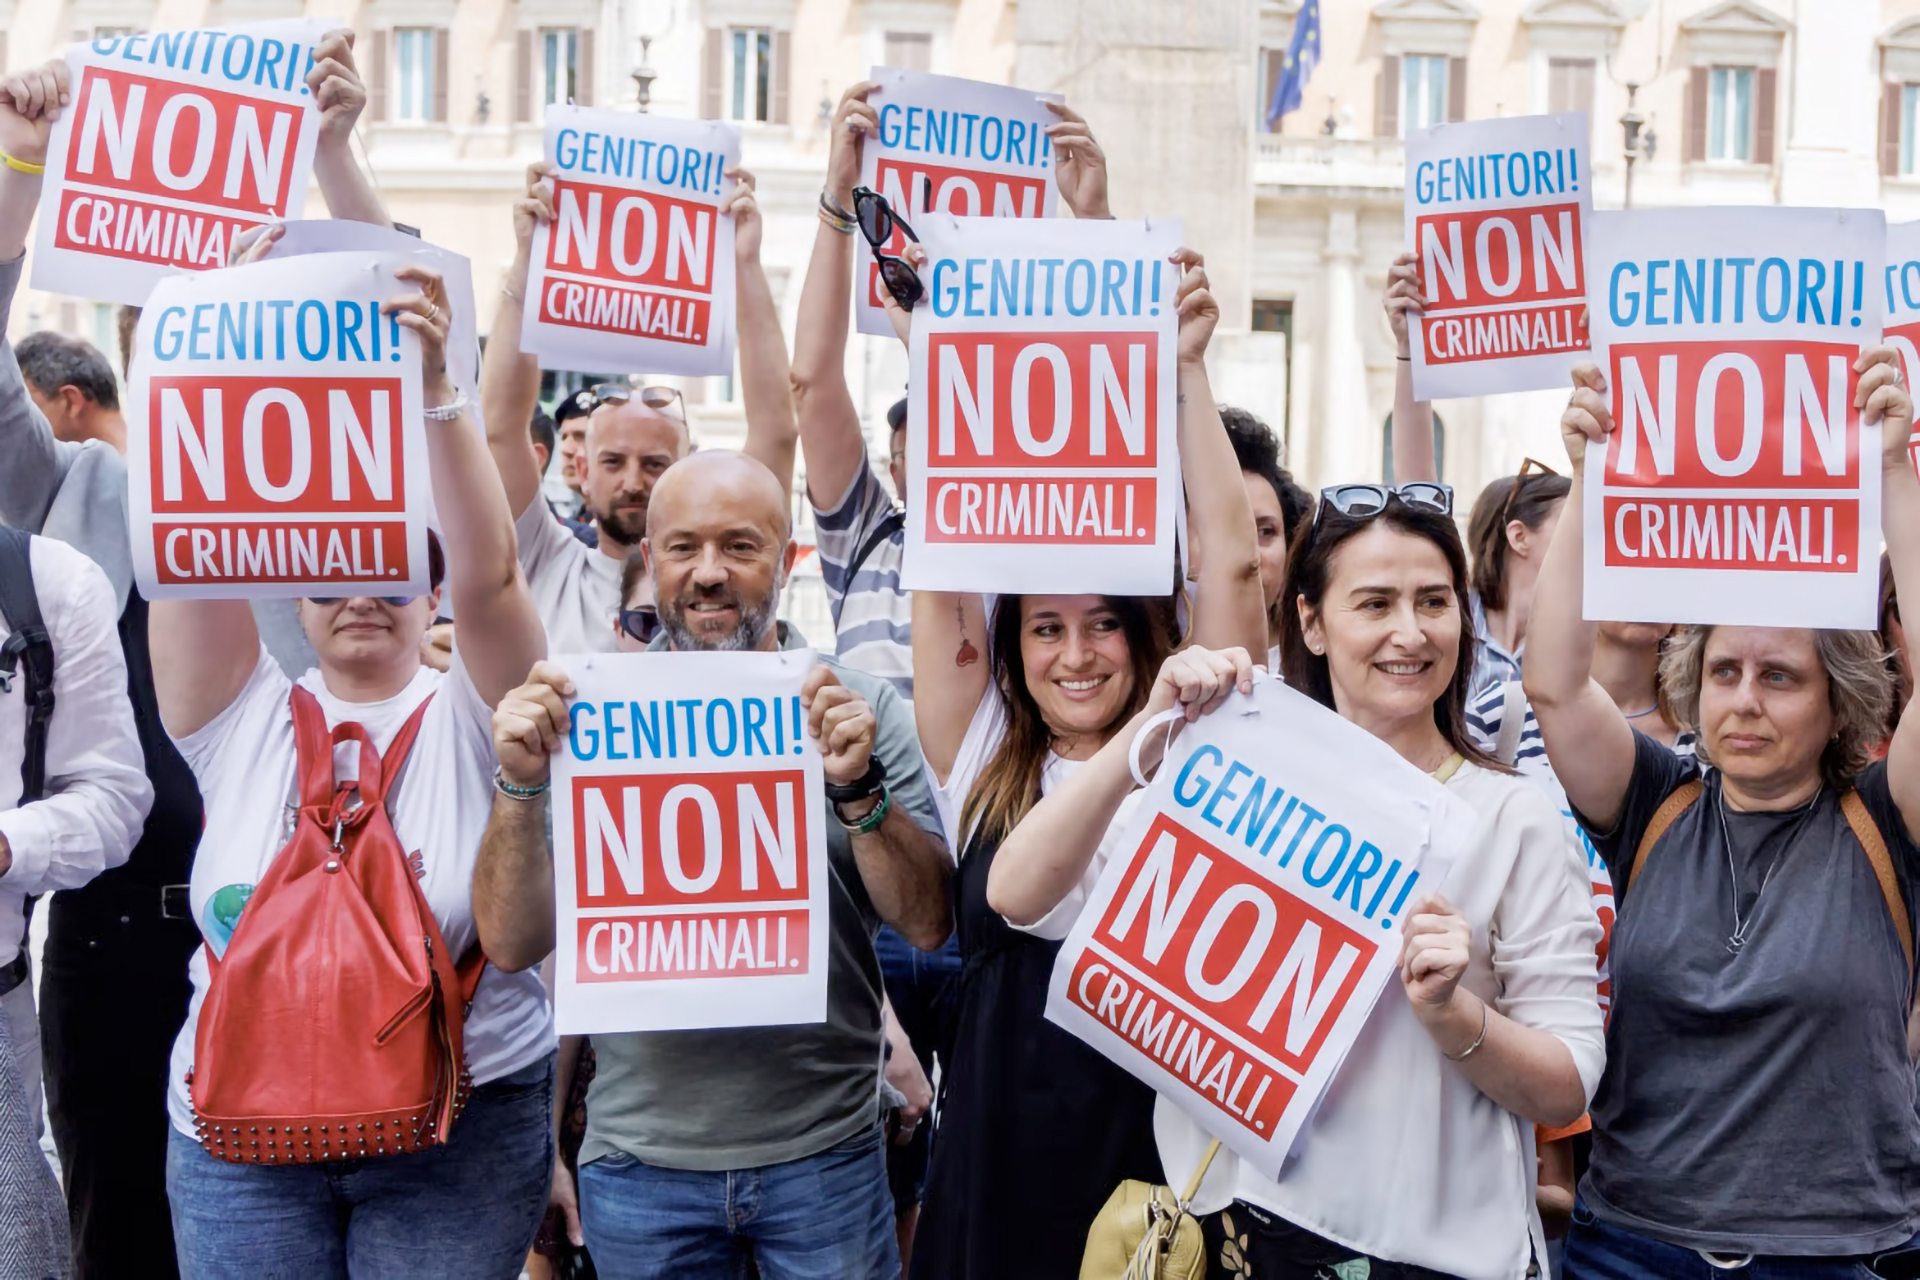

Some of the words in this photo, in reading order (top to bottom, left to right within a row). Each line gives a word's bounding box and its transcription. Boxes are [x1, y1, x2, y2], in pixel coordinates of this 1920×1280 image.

[76, 77, 293, 207] NON
[555, 128, 725, 195] GENITORI!
[879, 103, 1051, 168] GENITORI!
[1415, 147, 1580, 205] GENITORI!
[554, 189, 710, 286] NON
[1420, 210, 1577, 304] NON
[547, 281, 702, 343] CRIMINALI.
[931, 258, 1162, 319] GENITORI!
[1608, 256, 1865, 328] GENITORI!
[153, 298, 402, 362] GENITORI!
[1429, 310, 1583, 359] CRIMINALI.
[938, 343, 1147, 457] NON
[1615, 352, 1848, 477] NON
[161, 387, 393, 502] NON
[935, 481, 1147, 538] CRIMINALI.
[1615, 502, 1848, 565] CRIMINALI.
[165, 527, 399, 578] CRIMINALI.
[568, 696, 804, 762] GENITORI!
[583, 781, 798, 897] NON
[1172, 744, 1421, 930] GENITORI!
[585, 916, 800, 976] CRIMINALI.
[1108, 829, 1361, 1058] NON
[1078, 963, 1274, 1130] CRIMINALI.
